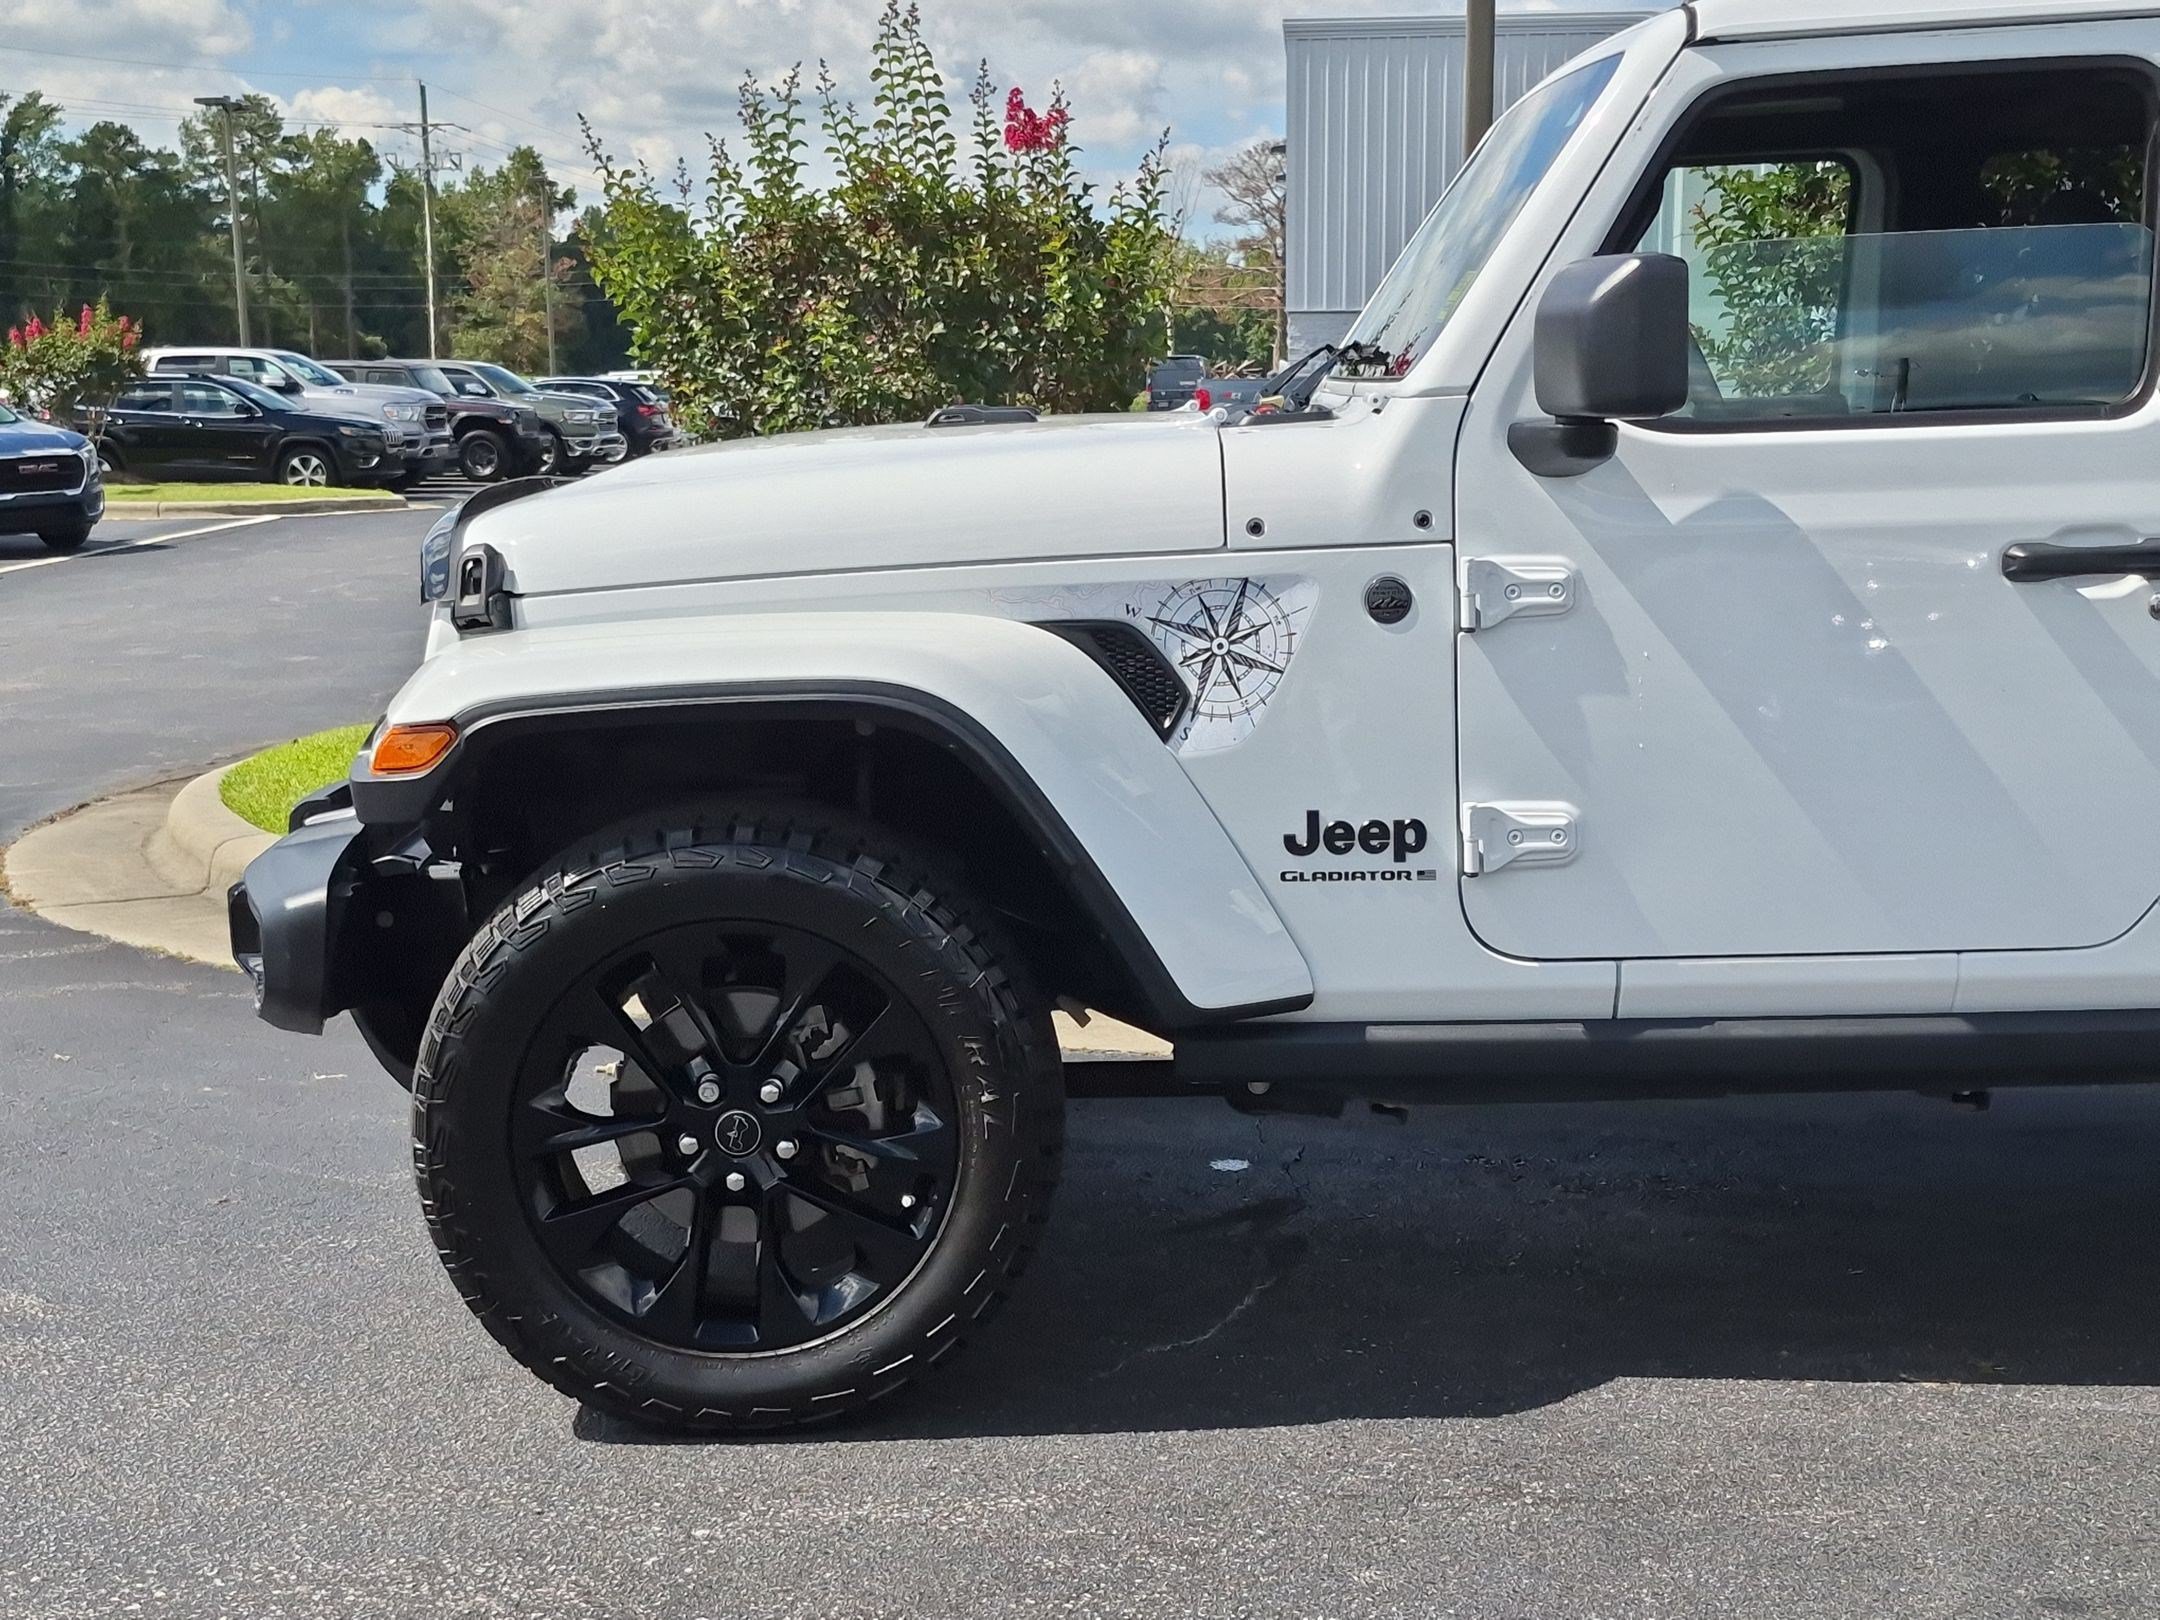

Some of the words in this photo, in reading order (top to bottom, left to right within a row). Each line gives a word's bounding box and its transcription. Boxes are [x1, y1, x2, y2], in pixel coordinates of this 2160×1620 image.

[1126, 603, 1142, 618] W
[1179, 727, 1191, 741] S
[1283, 810, 1428, 863] Jeep
[1280, 871, 1414, 883] GLADIATOR
